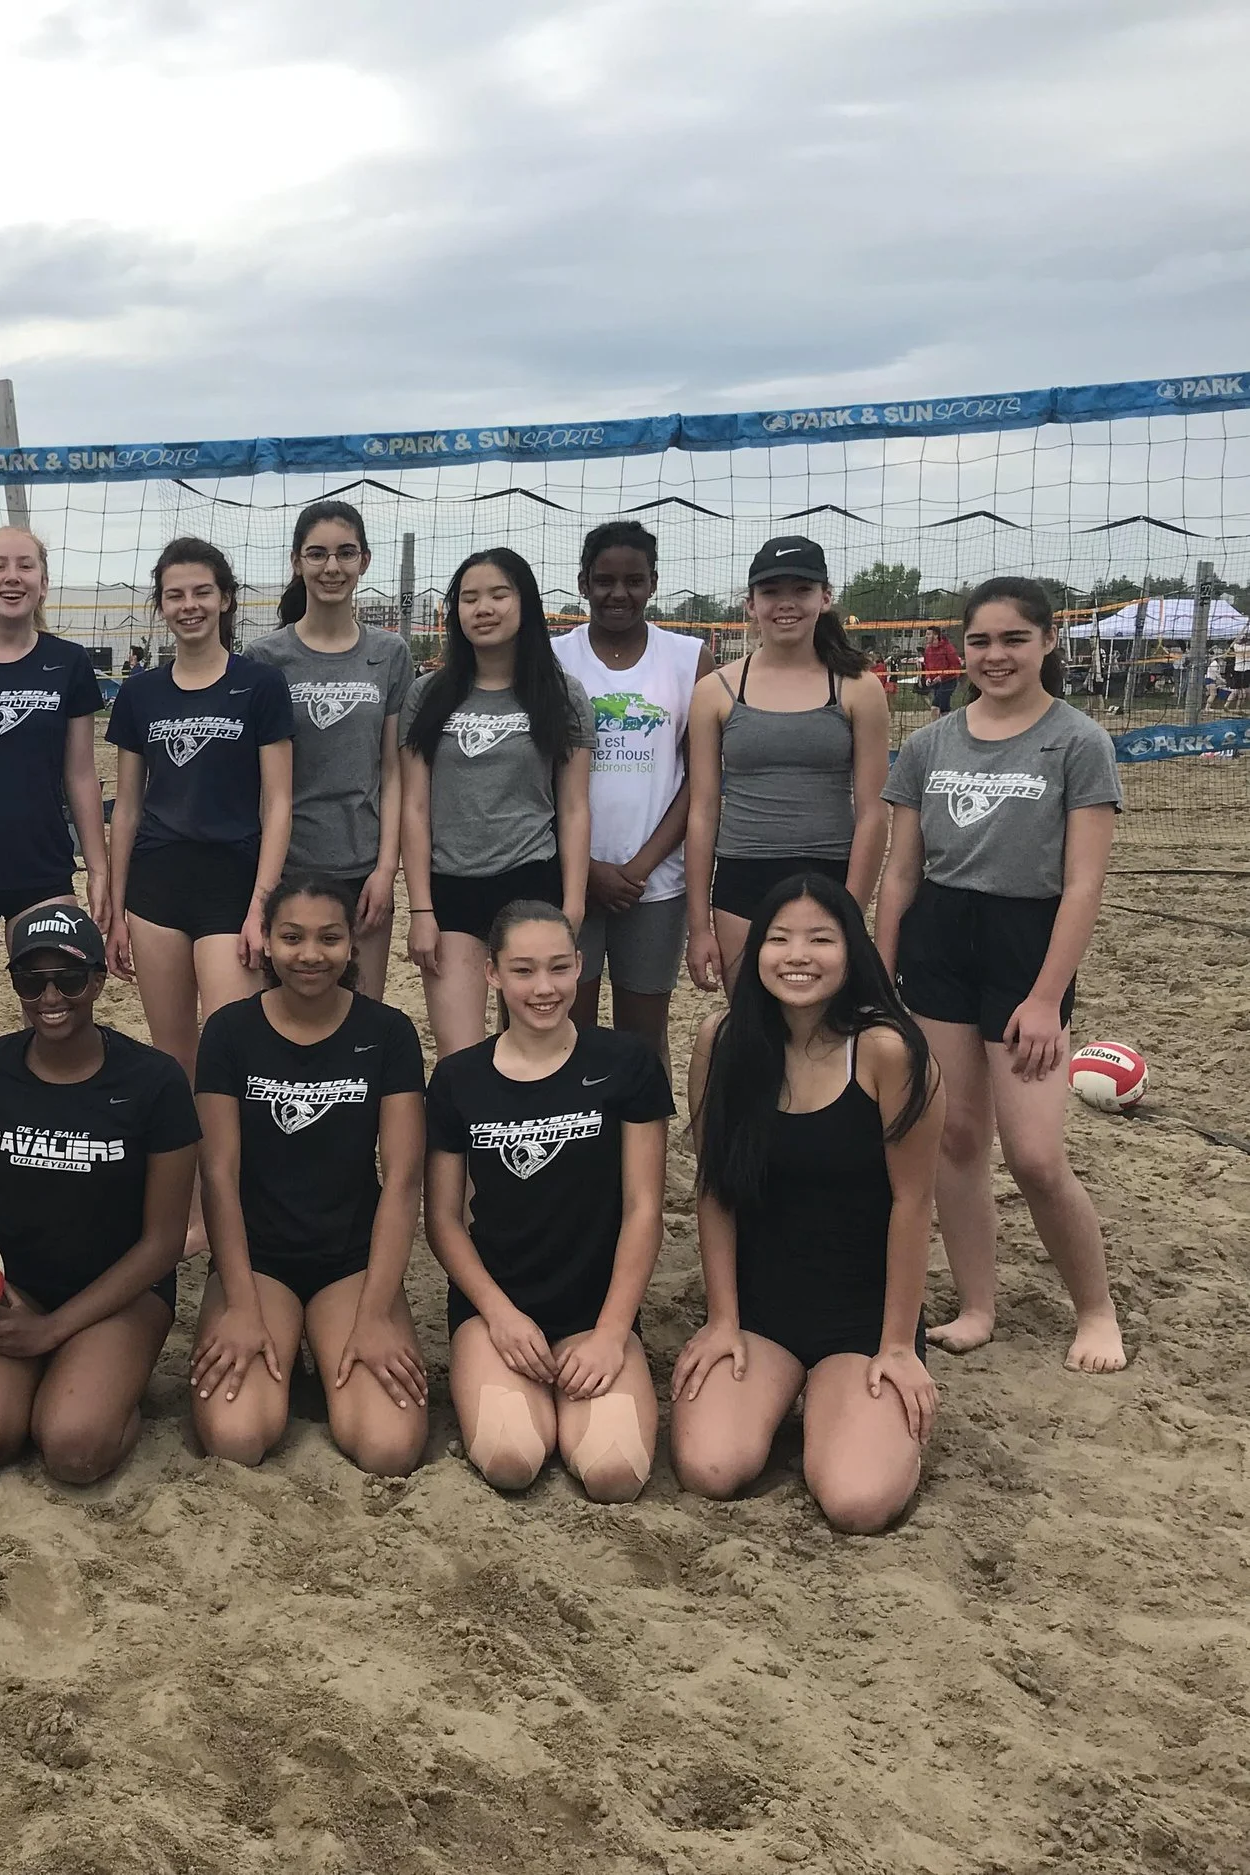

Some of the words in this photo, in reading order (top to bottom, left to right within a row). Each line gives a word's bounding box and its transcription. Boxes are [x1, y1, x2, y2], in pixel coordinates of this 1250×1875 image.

[1181, 376, 1244, 398] PARK
[791, 409, 853, 430] PARK
[861, 407, 879, 424] &
[388, 434, 448, 456] PARK
[454, 432, 472, 450] &
[45, 453, 62, 470] &
[402, 593, 413, 607] 23
[149, 716, 245, 727] VOLLEYBALL
[450, 720, 530, 731] AVALIER
[149, 725, 244, 740] CAVALIERS
[604, 735, 626, 748] est
[1153, 735, 1215, 753] PARK
[616, 747, 655, 761] nous!
[930, 770, 1048, 783] VOLLEYBALL
[926, 777, 1046, 800] CAVALIERS
[27, 919, 70, 936] PUMA
[1080, 1048, 1121, 1064] Wilson
[246, 1075, 368, 1089] VOLLEYBALL
[246, 1083, 367, 1103] CAVALIERS
[469, 1109, 603, 1131] VOLLEYBALL
[16, 1125, 33, 1134] DE
[35, 1128, 50, 1137] LA
[53, 1130, 90, 1140] SALLE
[472, 1123, 601, 1149] CAVALIERS
[12, 1156, 89, 1171] VOLLEYBALL
